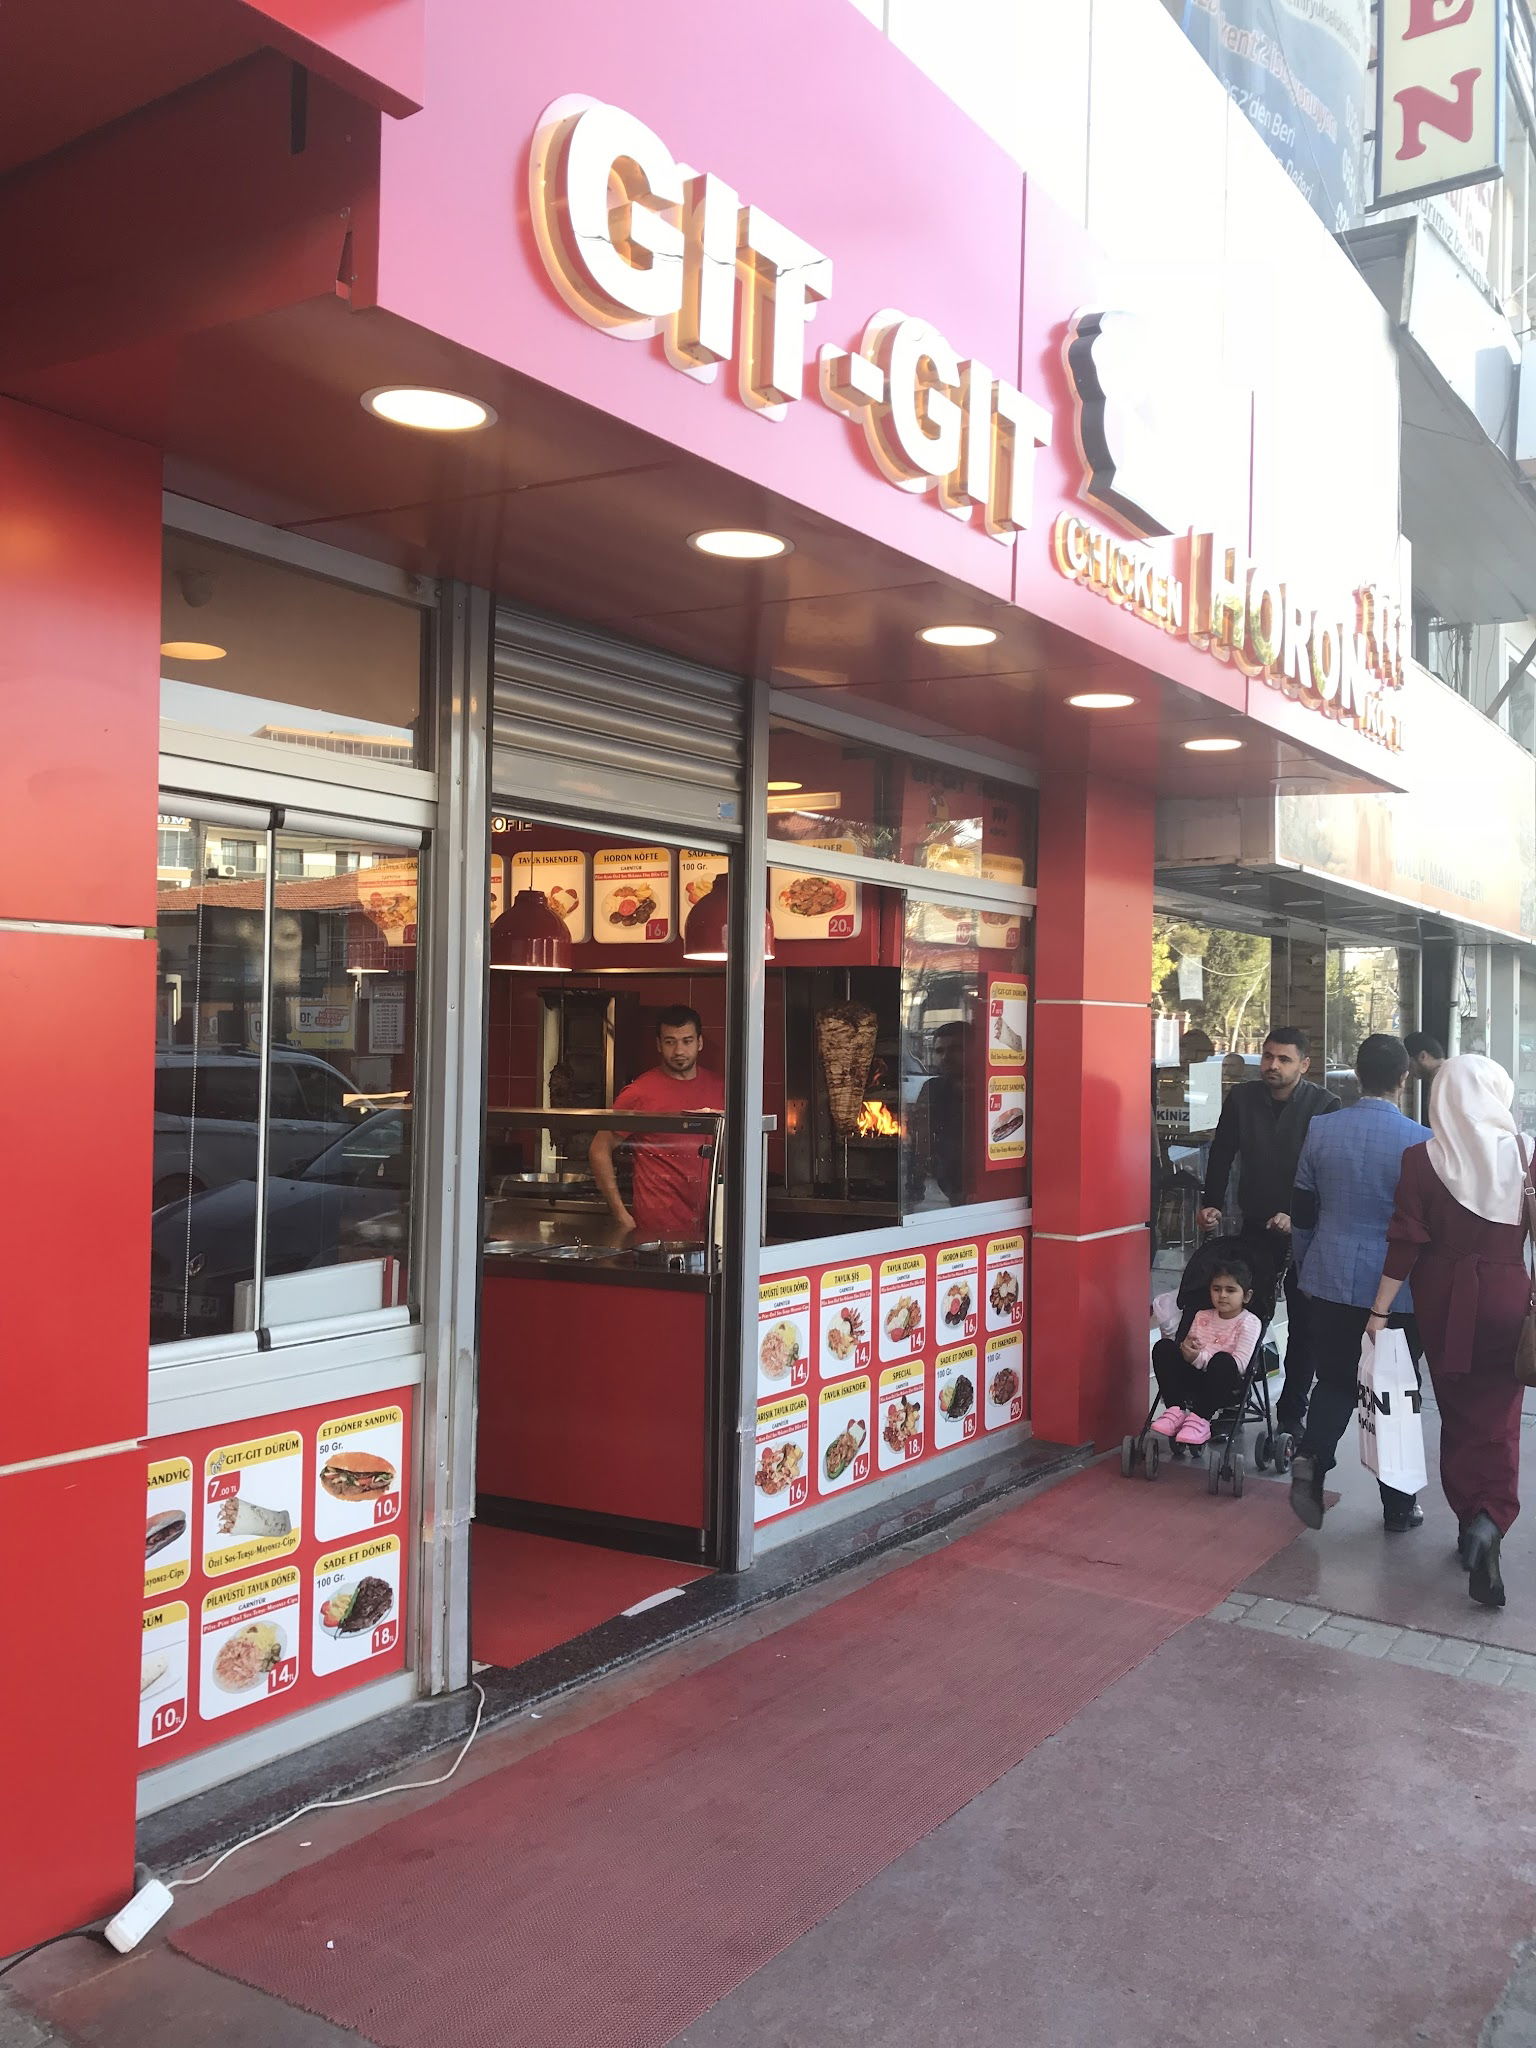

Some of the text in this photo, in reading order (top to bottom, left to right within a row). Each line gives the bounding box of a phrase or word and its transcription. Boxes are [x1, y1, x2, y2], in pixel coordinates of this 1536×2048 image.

[1060, 514, 1183, 630] CHICKEN
[1198, 532, 1364, 719] HORON
[604, 854, 632, 862] HORON
[697, 862, 708, 870] Gr.
[943, 1252, 959, 1260] HORON
[887, 1264, 902, 1273] TAVUK
[834, 1275, 850, 1283] TAVUK
[824, 1391, 840, 1401] TAVUK
[774, 1406, 789, 1414] TAVUK
[322, 1412, 398, 1437] ET DÖNER SANDVİÇ
[264, 1439, 300, 1455] DÜRÜM
[319, 1442, 344, 1454] 50 Gr.
[323, 1541, 392, 1571] SADE ET DÖNER
[247, 1581, 269, 1595] TAVUK
[270, 1572, 296, 1587] DÖNER
[316, 1573, 346, 1589] 100 Gr.
